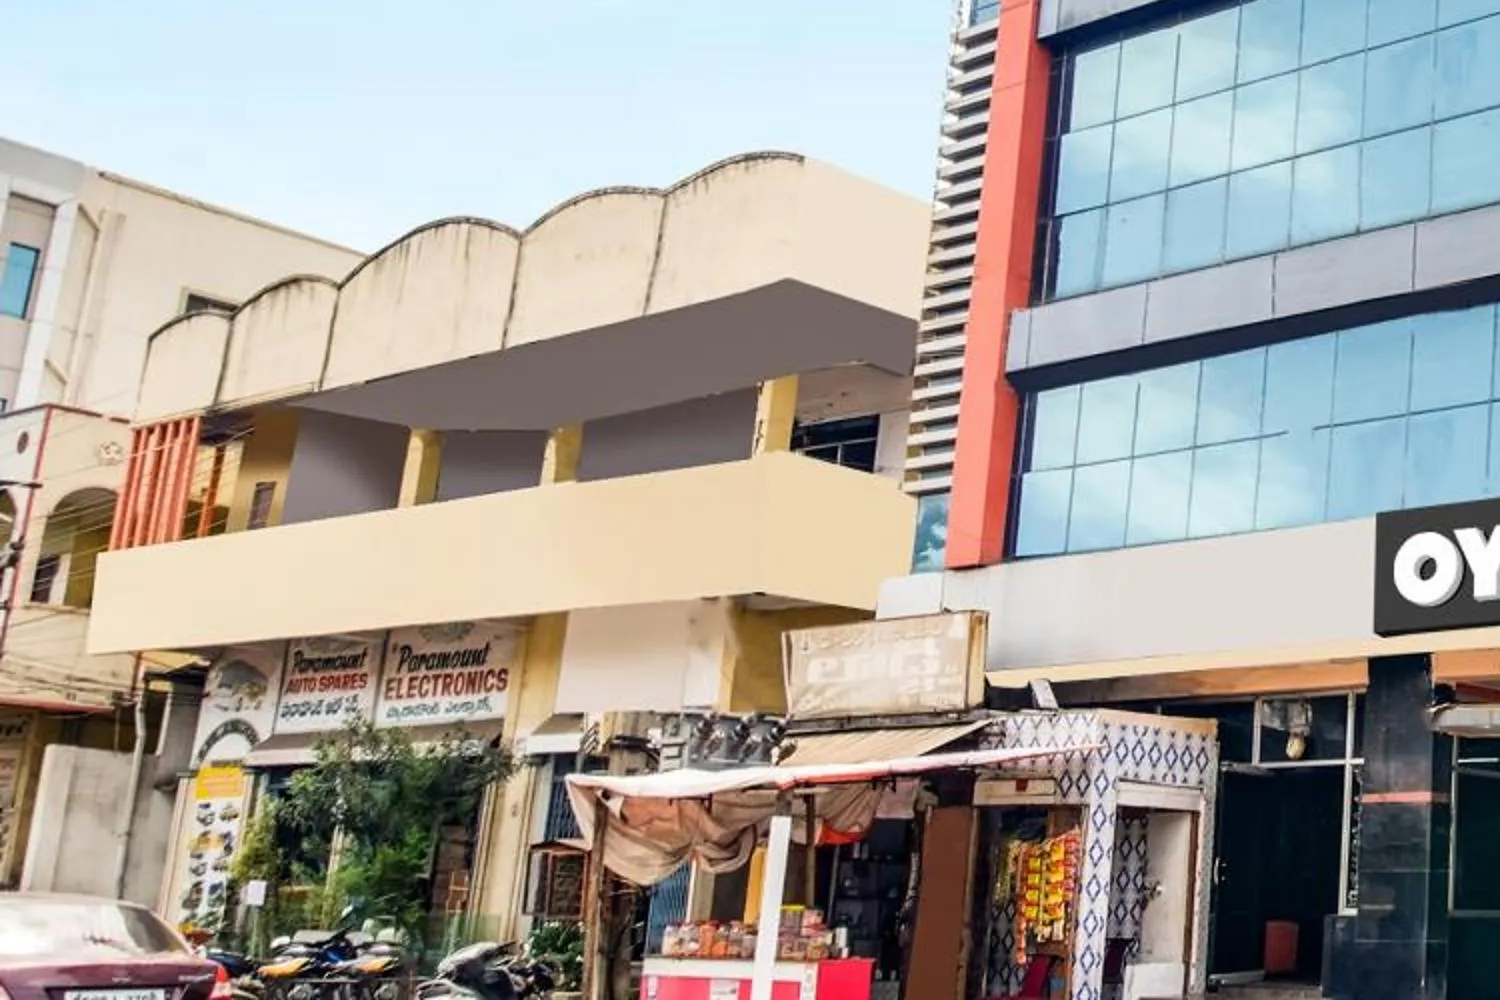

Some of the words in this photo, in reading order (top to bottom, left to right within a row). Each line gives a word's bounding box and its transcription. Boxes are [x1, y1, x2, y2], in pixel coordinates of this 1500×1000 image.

[291, 647, 368, 674] Paramount
[285, 677, 317, 696] AUTO
[318, 672, 369, 692] SPARES
[383, 668, 509, 701] ELECTRONICS
